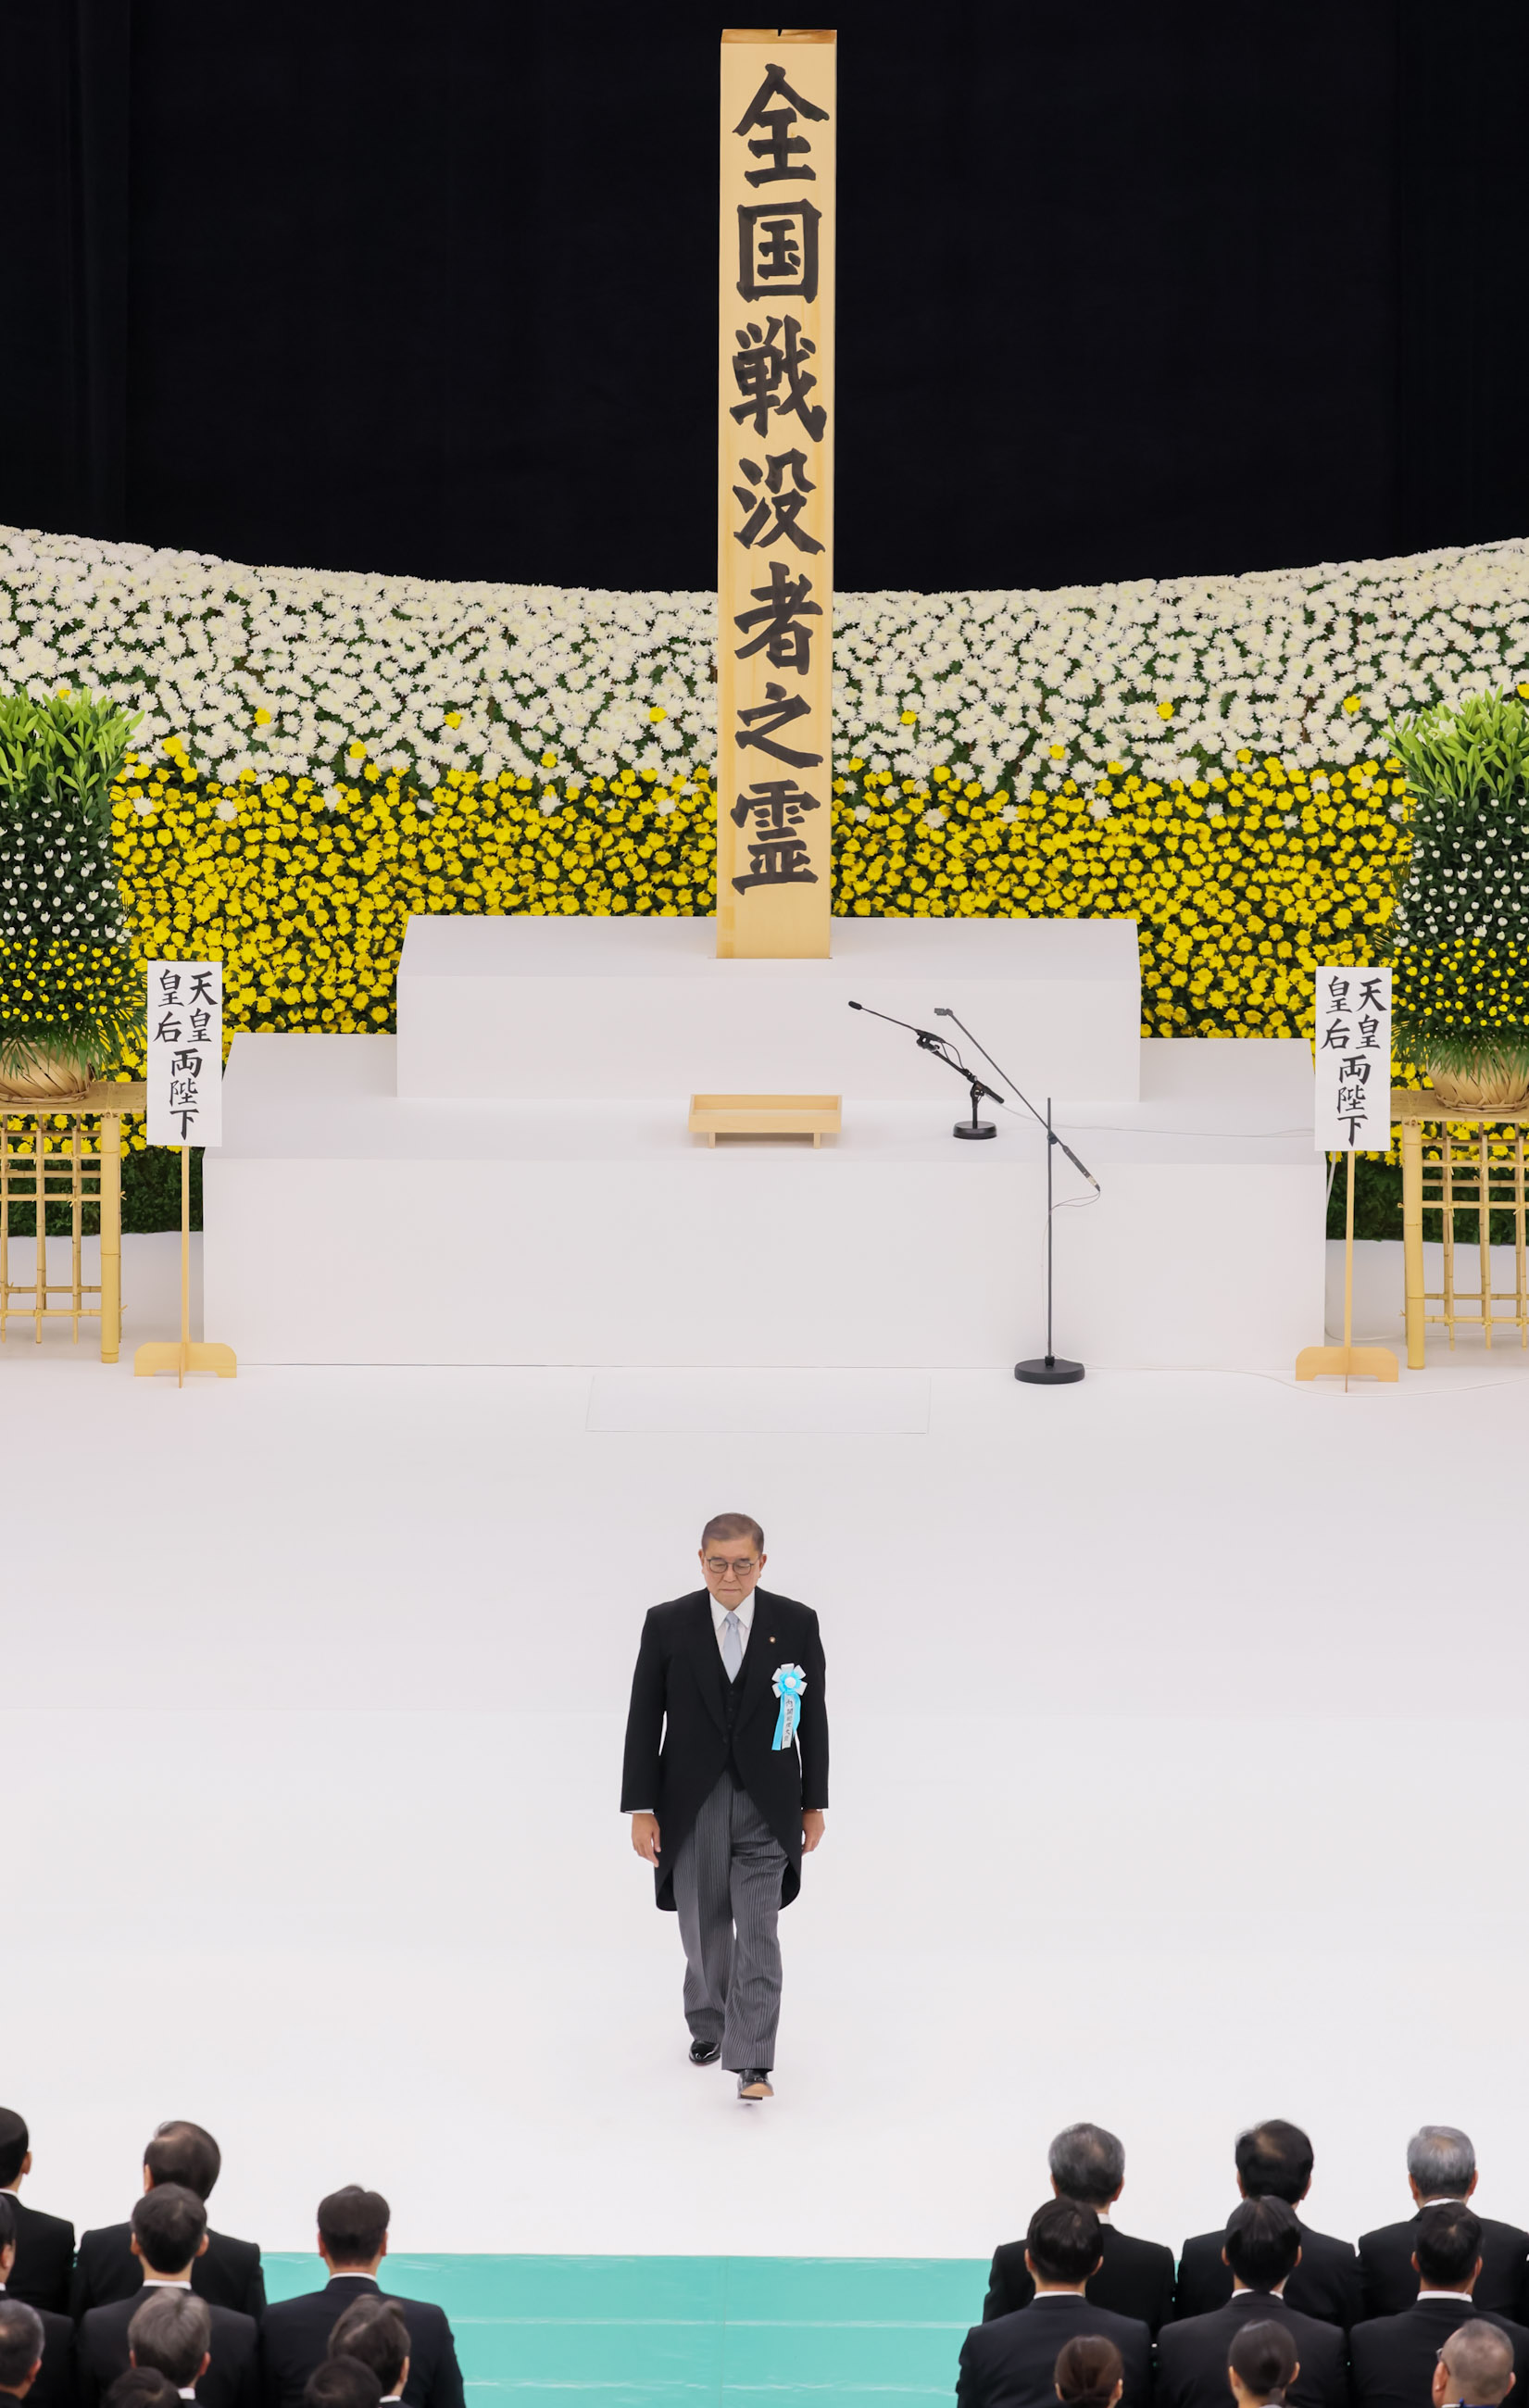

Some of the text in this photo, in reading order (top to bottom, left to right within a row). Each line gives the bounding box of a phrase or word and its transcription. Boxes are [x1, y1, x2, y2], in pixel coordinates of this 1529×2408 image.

[730, 64, 829, 895] 全国戦没者之霊
[154, 970, 183, 1042] 皇后
[187, 972, 218, 1042] 天皇
[1322, 976, 1352, 1048] 皇后
[1356, 978, 1386, 1049] 天皇
[169, 1048, 202, 1140] 両陛下
[1337, 1054, 1371, 1147] 両陛下
